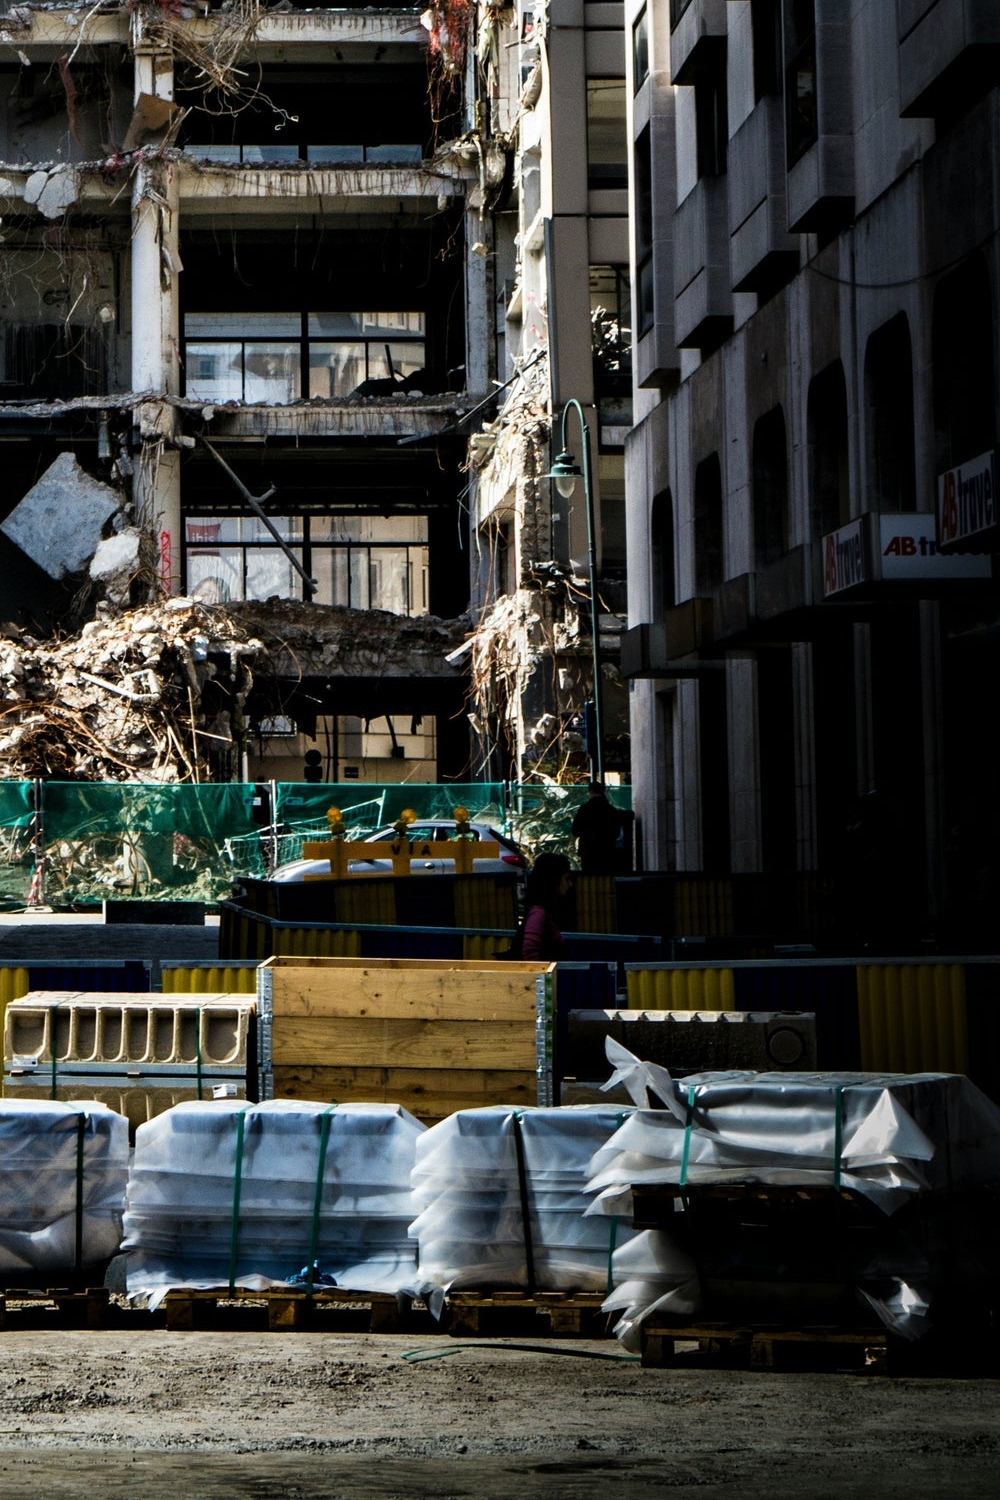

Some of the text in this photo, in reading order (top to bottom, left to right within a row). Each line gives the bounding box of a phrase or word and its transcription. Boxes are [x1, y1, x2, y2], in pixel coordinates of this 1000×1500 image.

[941, 453, 997, 542] AB travel
[836, 520, 865, 590] travel
[883, 536, 917, 556] AB
